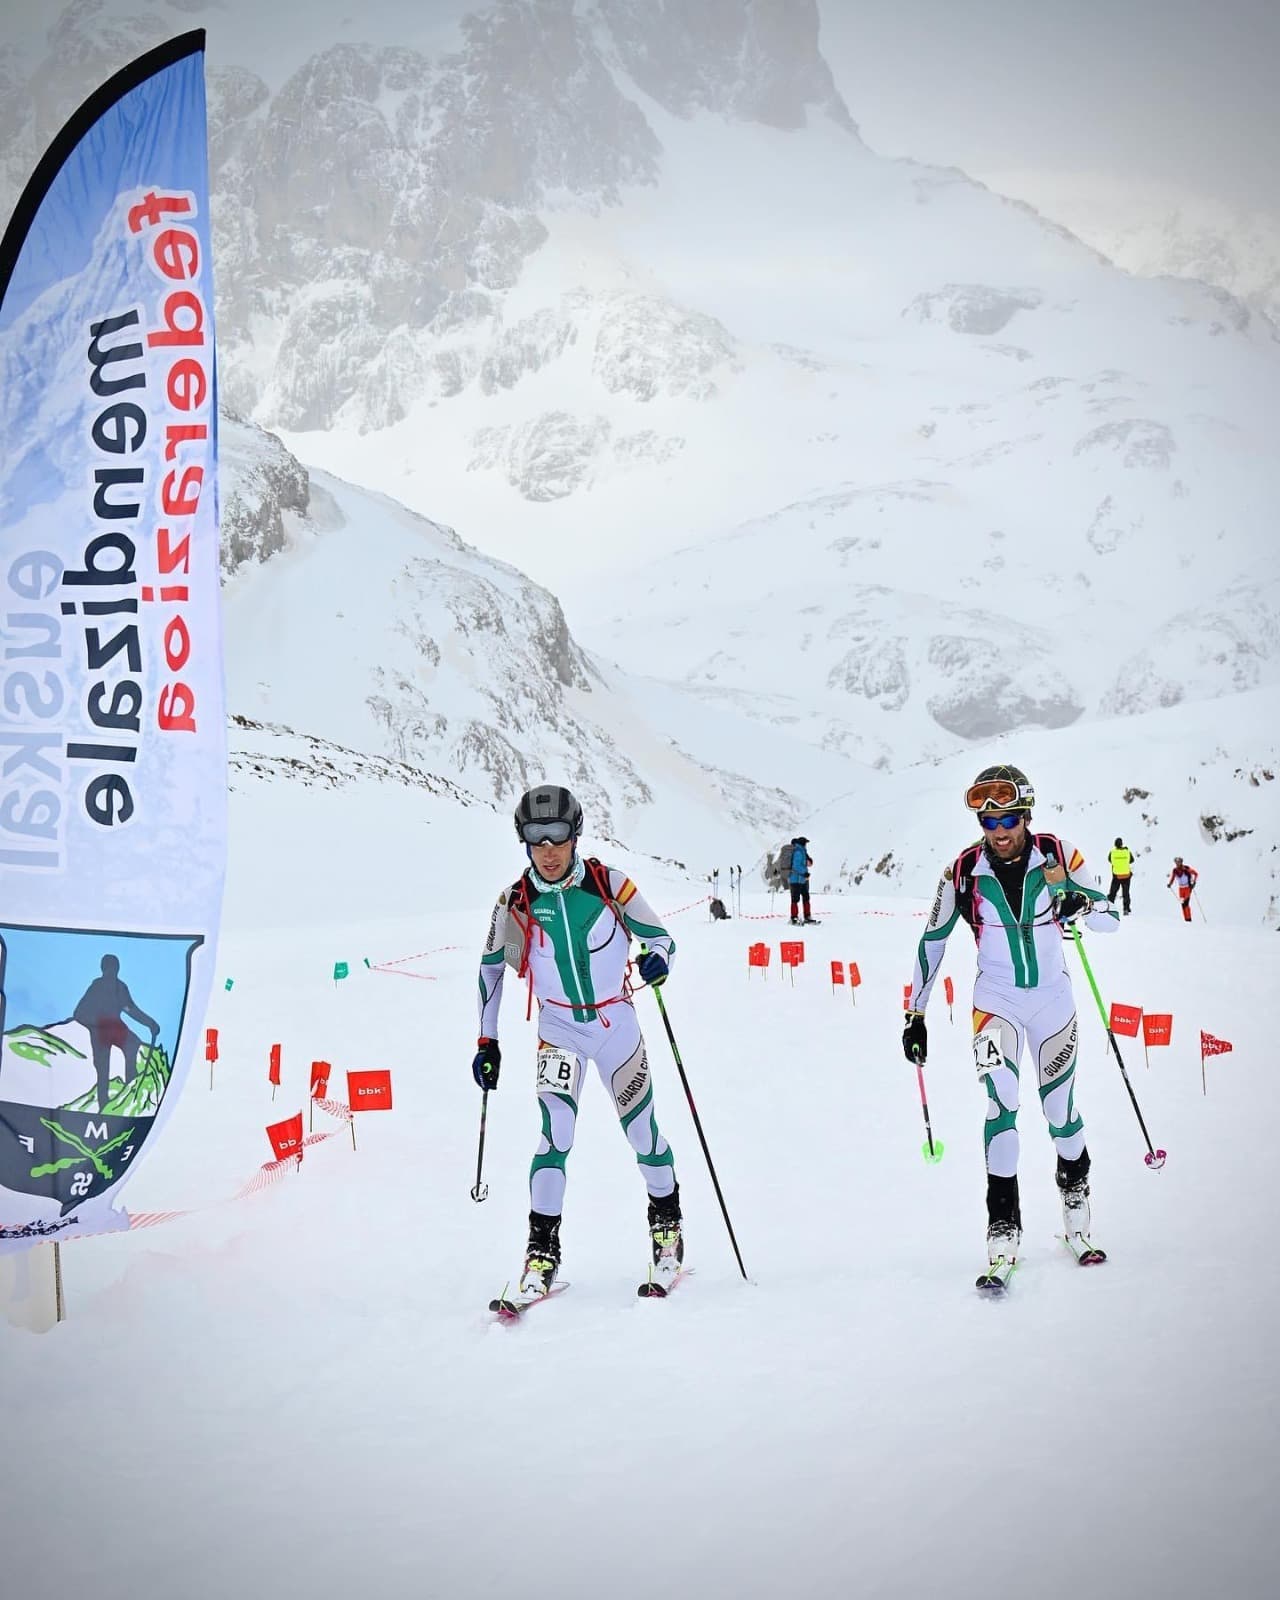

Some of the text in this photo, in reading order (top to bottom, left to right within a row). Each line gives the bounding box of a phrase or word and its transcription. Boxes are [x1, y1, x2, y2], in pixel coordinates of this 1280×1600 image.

[534, 908, 556, 916] GUARDIA
[987, 1040, 999, 1059] A
[1044, 1043, 1075, 1077] GUARDIA
[558, 1061, 572, 1081] B
[358, 1087, 382, 1096] bbk
[617, 1071, 648, 1106] GUARDIA
